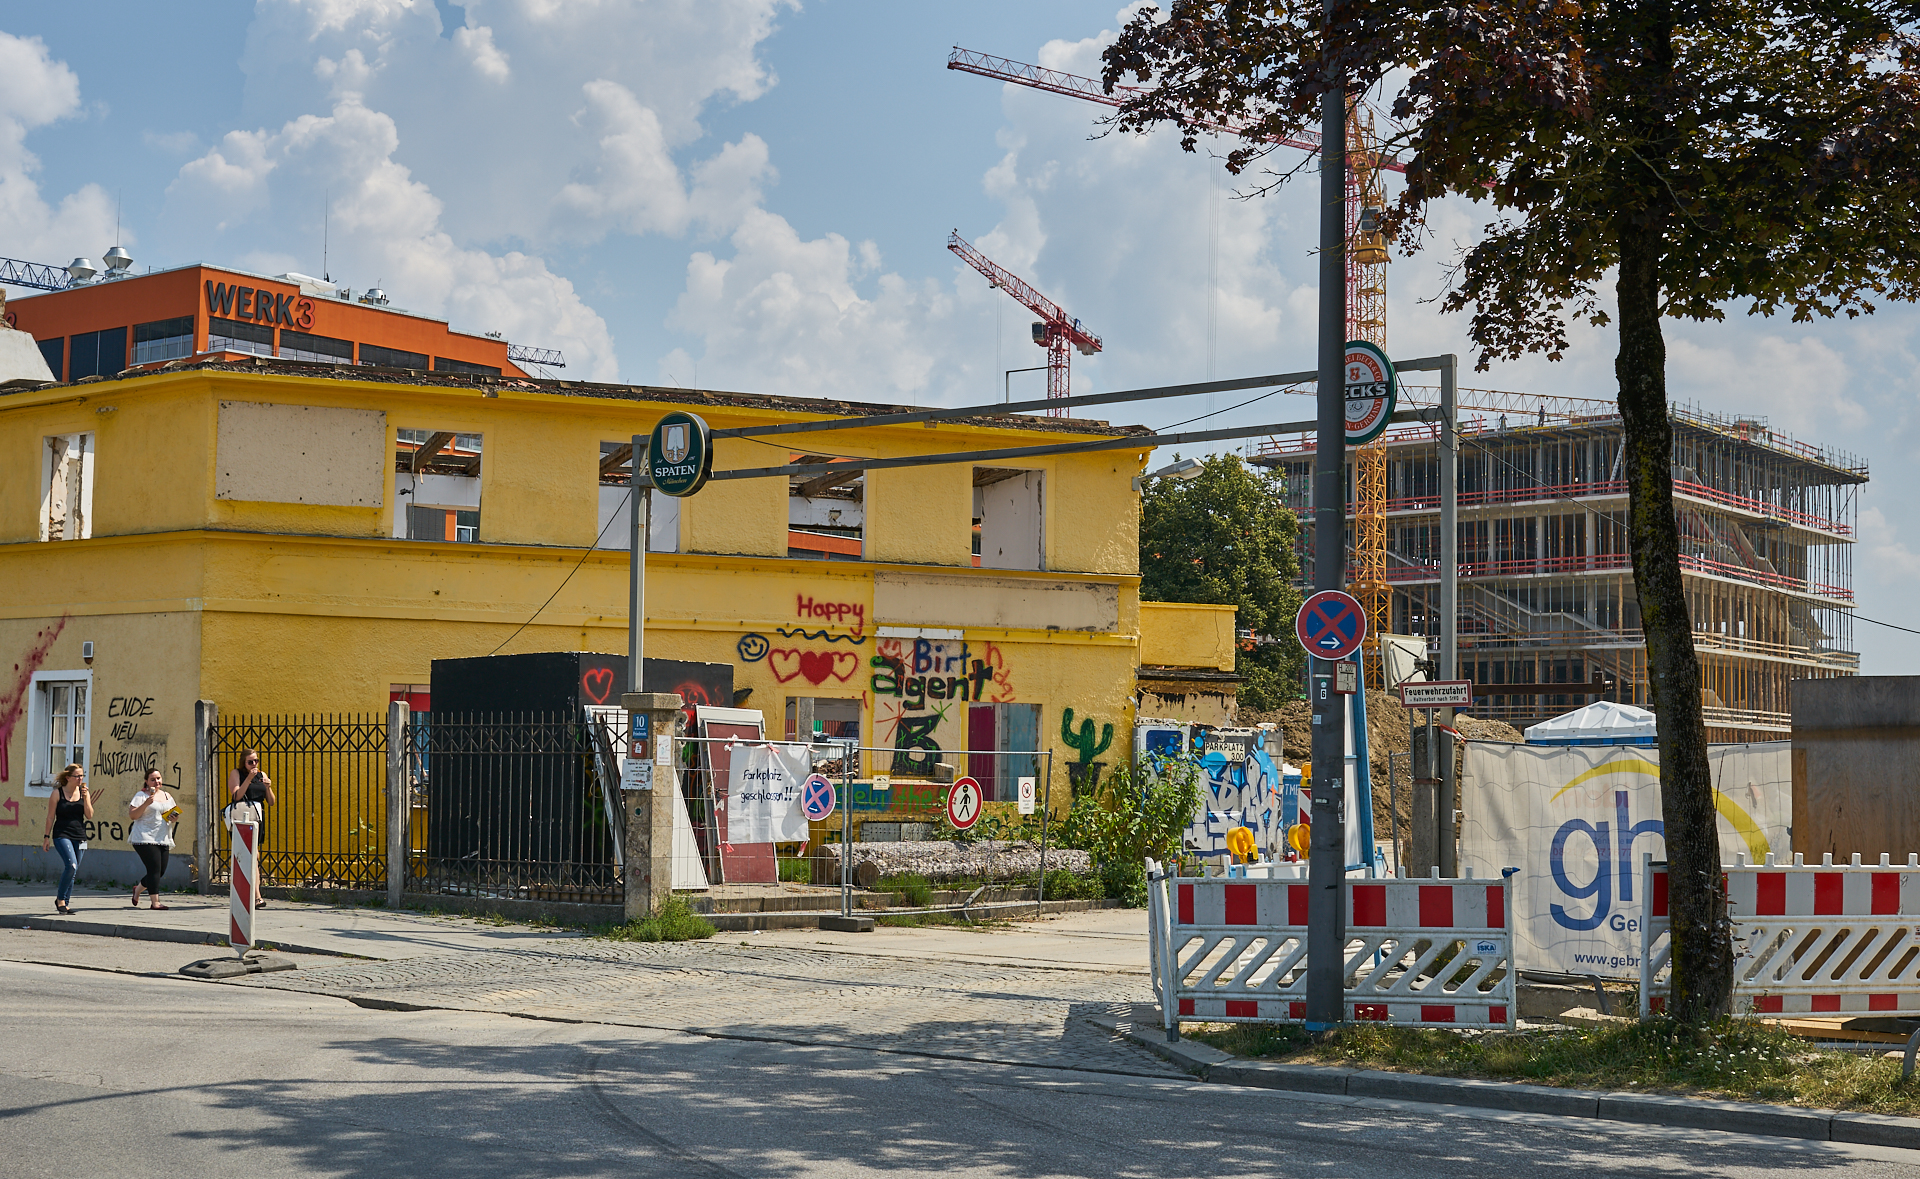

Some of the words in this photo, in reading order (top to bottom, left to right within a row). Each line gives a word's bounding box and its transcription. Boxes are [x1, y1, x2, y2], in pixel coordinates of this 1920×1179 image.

[206, 279, 317, 329] WERK3
[1345, 382, 1387, 399] ECK'S
[1354, 400, 1382, 430] GERMANY
[655, 464, 696, 478] SPATEN
[797, 593, 864, 636] Happy
[1404, 686, 1467, 696] Feuerwehrzufahrt
[108, 697, 155, 718] ENDE
[635, 715, 645, 728] 10
[1205, 742, 1244, 752] PARKPLATZ
